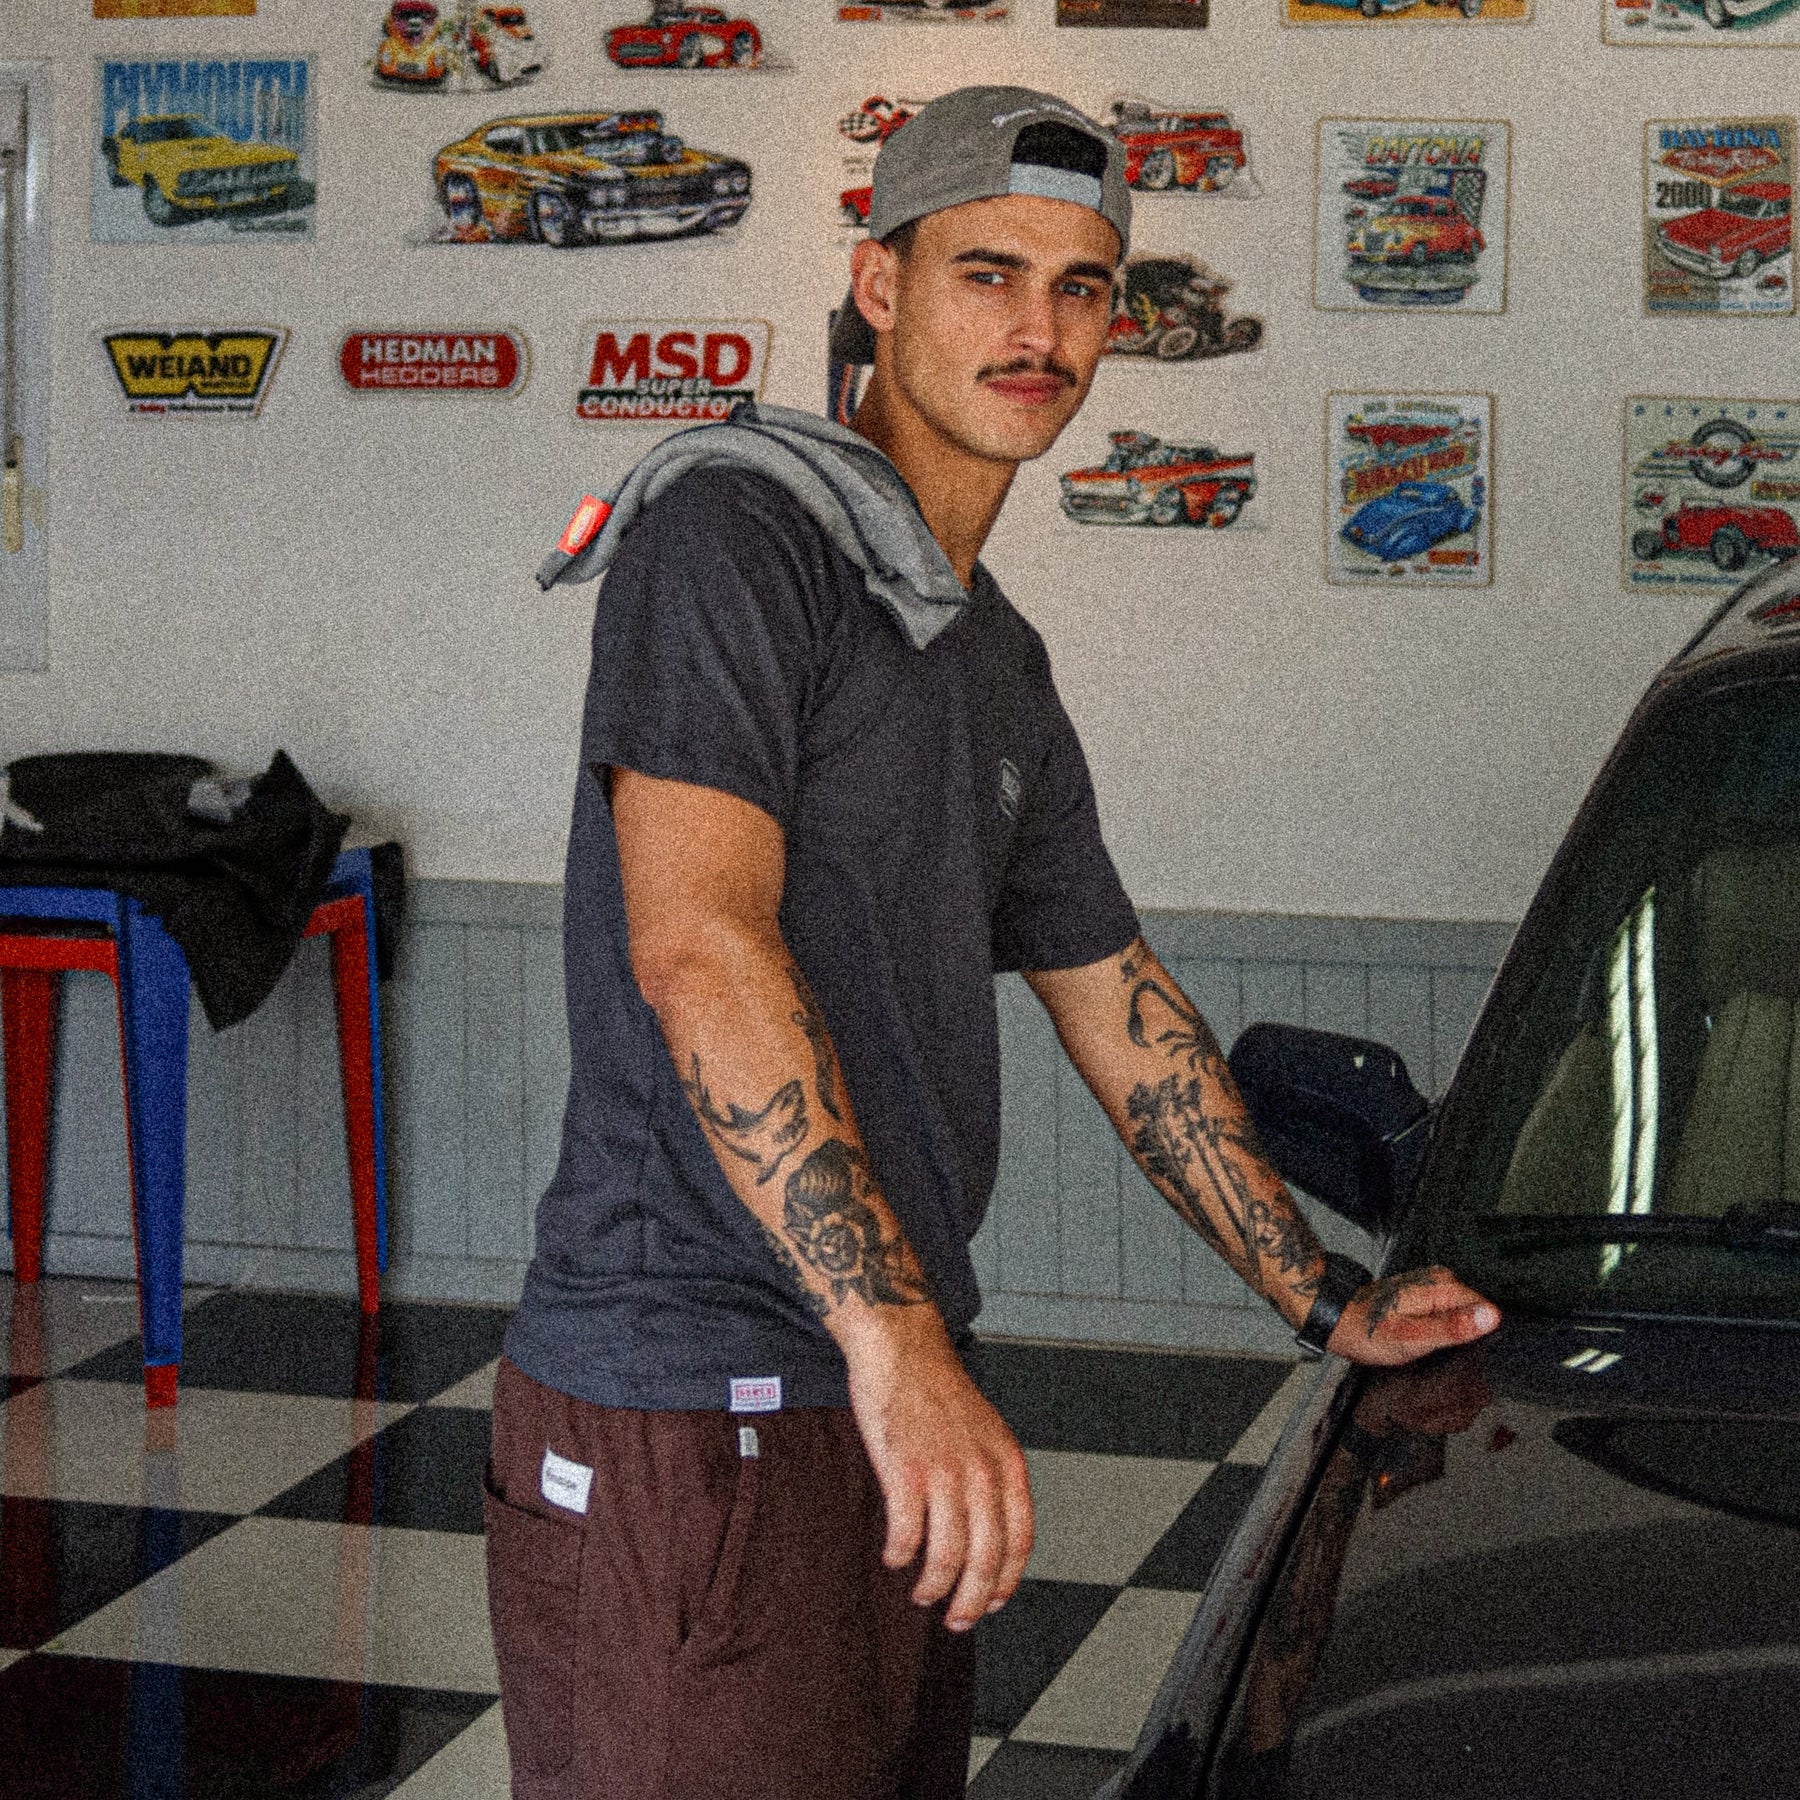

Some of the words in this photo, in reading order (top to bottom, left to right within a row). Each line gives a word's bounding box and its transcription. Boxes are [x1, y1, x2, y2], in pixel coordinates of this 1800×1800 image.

[1364, 134, 1484, 166] DAYTONA
[1660, 128, 1782, 149] DAYTONA
[1655, 181, 1712, 209] 2000
[361, 338, 497, 364] HEDMAN
[588, 331, 753, 387] MSD
[126, 354, 253, 379] WEIAND
[360, 366, 499, 385] HEDDERS
[636, 378, 712, 396] SUPER
